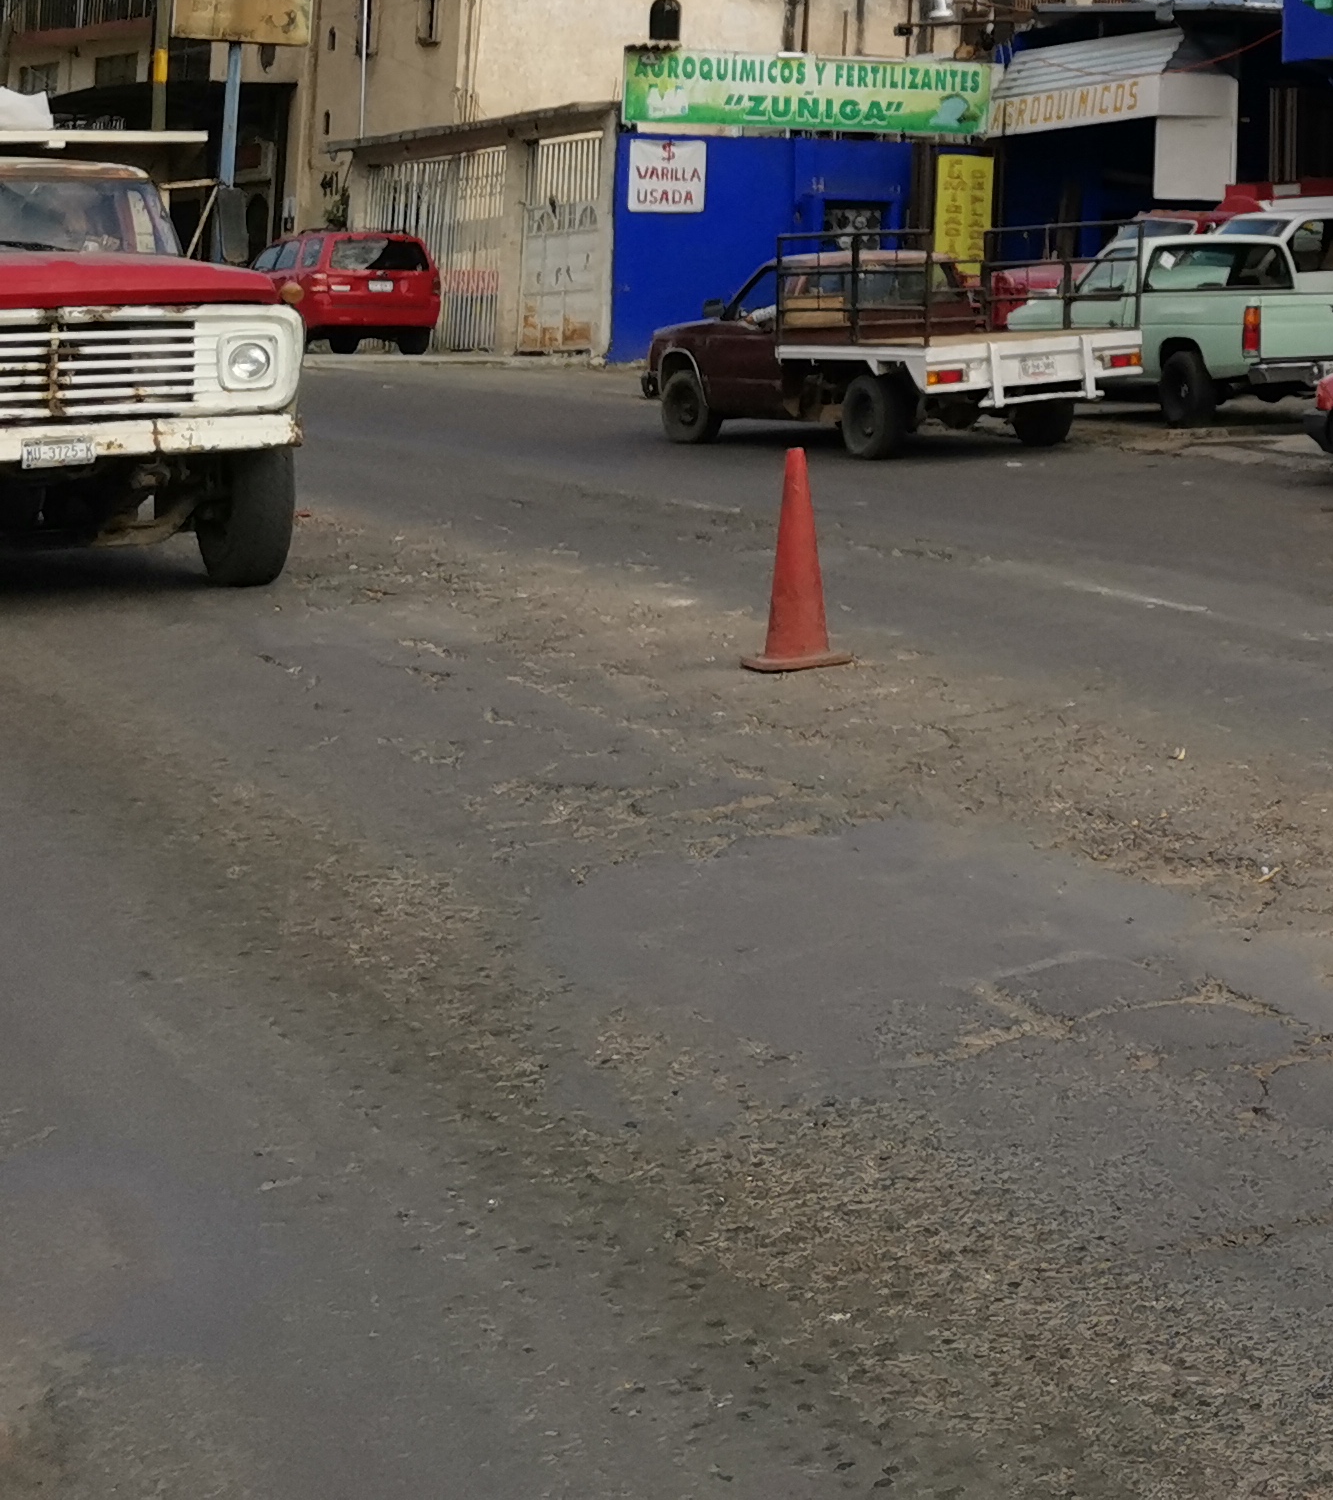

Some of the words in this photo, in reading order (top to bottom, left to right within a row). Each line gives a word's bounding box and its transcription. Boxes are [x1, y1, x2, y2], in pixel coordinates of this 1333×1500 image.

[815, 62, 827, 86] Y
[835, 63, 980, 93] FERTILIZANTES
[991, 81, 1139, 131] AGROQUIMICOS
[635, 165, 701, 182] VARILLA
[636, 188, 694, 204] USADA
